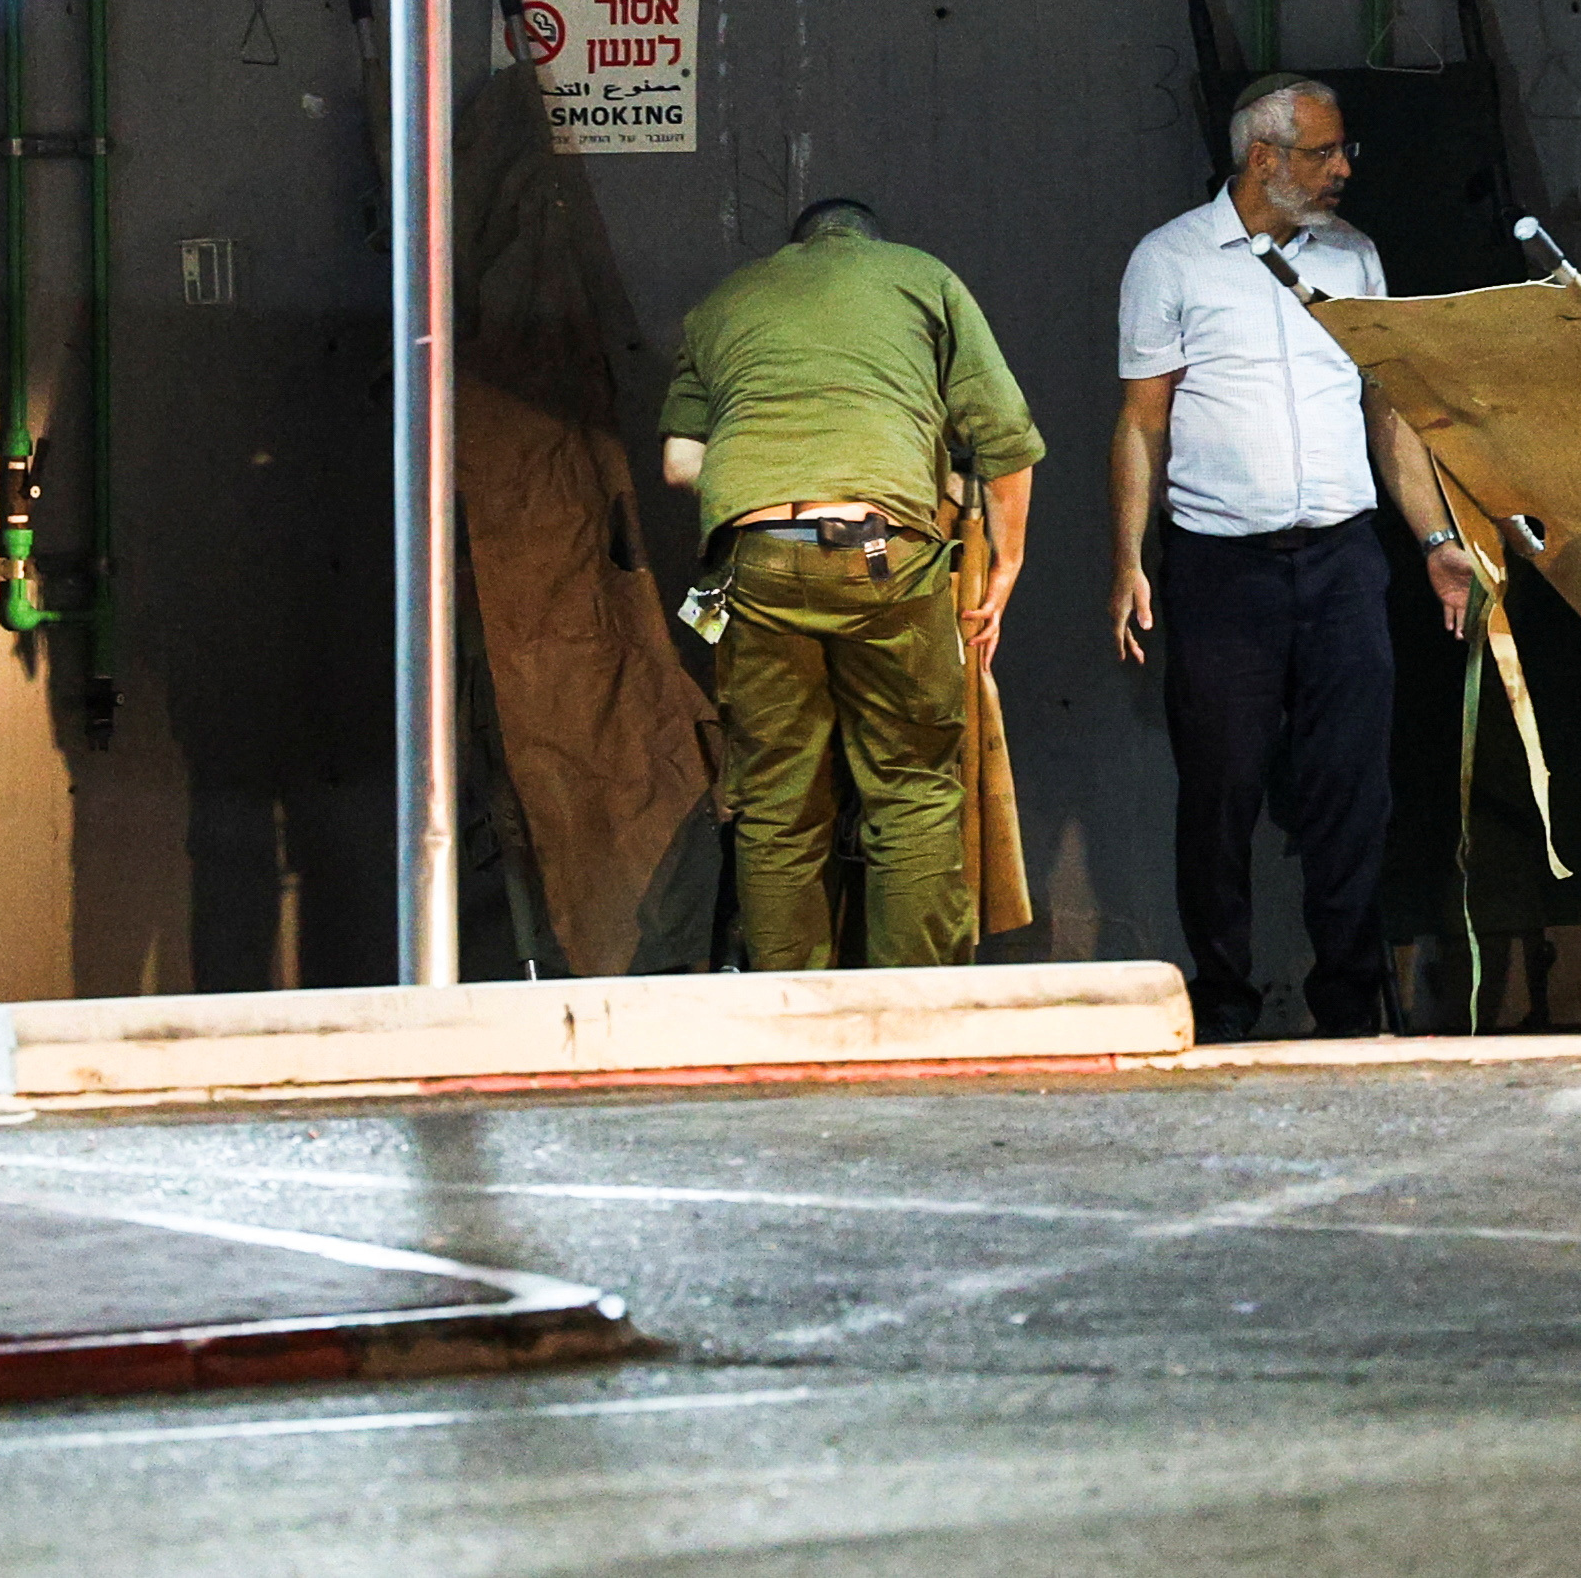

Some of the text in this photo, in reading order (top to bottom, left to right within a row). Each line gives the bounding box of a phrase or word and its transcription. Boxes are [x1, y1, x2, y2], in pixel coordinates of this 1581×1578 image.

[586, 34, 683, 74] לעשן
[603, 79, 682, 101] ممنوع
[550, 105, 684, 127] SMOKING
